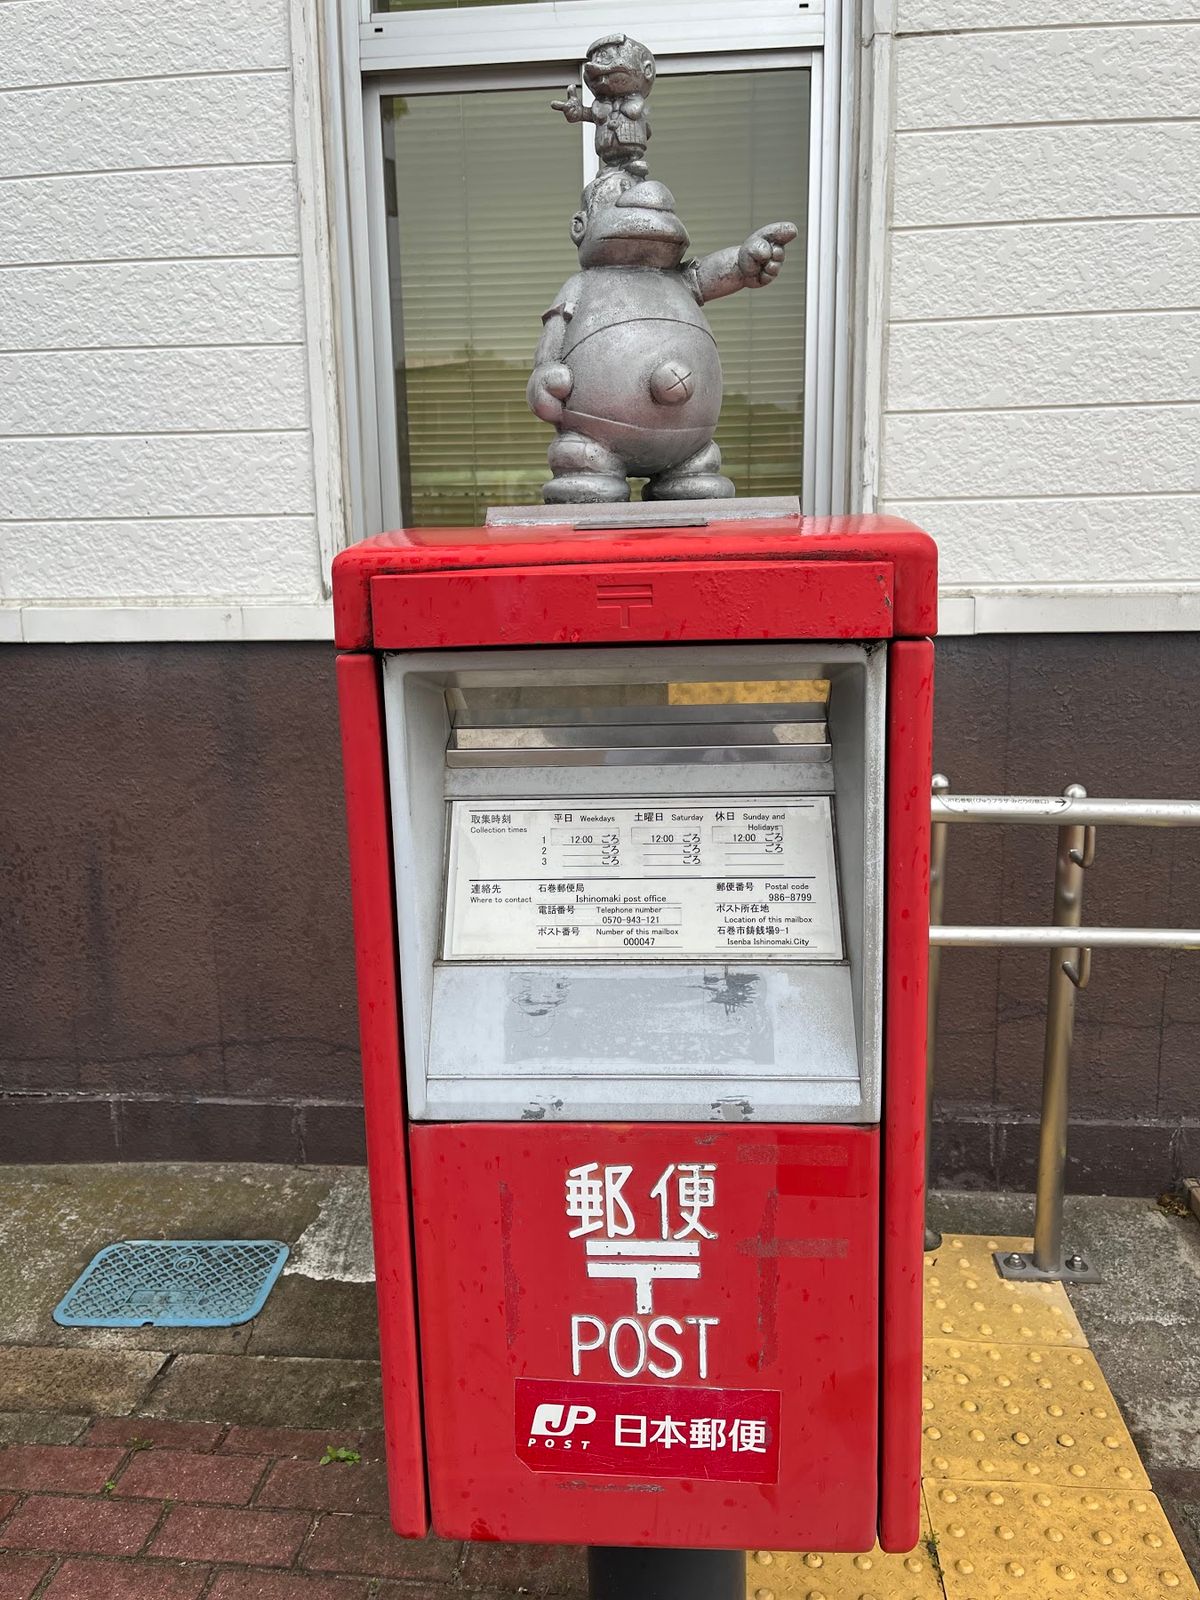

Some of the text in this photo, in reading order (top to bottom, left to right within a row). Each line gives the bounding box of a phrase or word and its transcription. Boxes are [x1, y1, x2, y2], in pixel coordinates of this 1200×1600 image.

[471, 814, 511, 823] 取集時刻
[554, 814, 572, 822] 平日
[634, 812, 663, 821] 土曜日
[715, 811, 734, 821] 休日
[602, 834, 619, 844] ごろ
[651, 833, 700, 843] 12:00 ごろ
[765, 832, 783, 842] ごろ
[602, 845, 619, 855] ごろ
[682, 844, 700, 854] ごろ
[765, 843, 783, 853] ごろ
[602, 856, 619, 866] ごろ
[682, 855, 700, 864] ごろ
[471, 884, 501, 893] 連絡先
[538, 883, 584, 892] 石巻郵便局
[716, 882, 754, 891] 郵便番号
[538, 906, 575, 914] 電話番号
[716, 904, 769, 912] ポスト所在地
[538, 927, 580, 936] ポスト番号
[624, 938, 655, 946] 000047
[566, 1162, 718, 1240] 郵便
[571, 1315, 719, 1378] POST
[531, 1404, 596, 1436] JP
[614, 1415, 767, 1453] 日本郵便
[528, 1439, 590, 1450] POST
